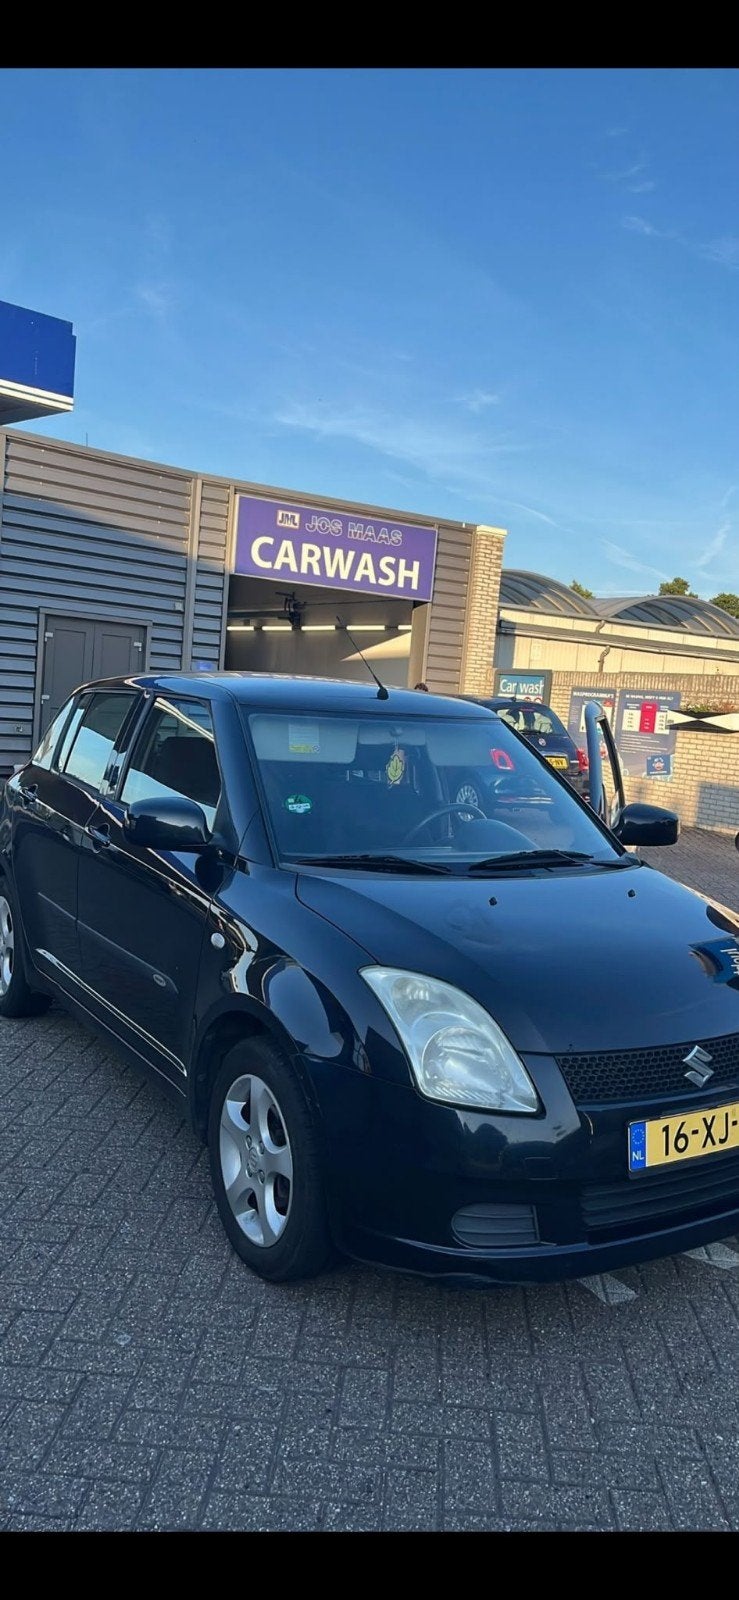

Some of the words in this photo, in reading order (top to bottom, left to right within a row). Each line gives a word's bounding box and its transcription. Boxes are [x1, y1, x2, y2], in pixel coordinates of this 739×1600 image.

[305, 515, 343, 537] JOS
[347, 522, 403, 546] MAAS
[250, 536, 420, 590] CARWASH
[500, 679, 517, 692] Car
[632, 1150, 645, 1161] NL
